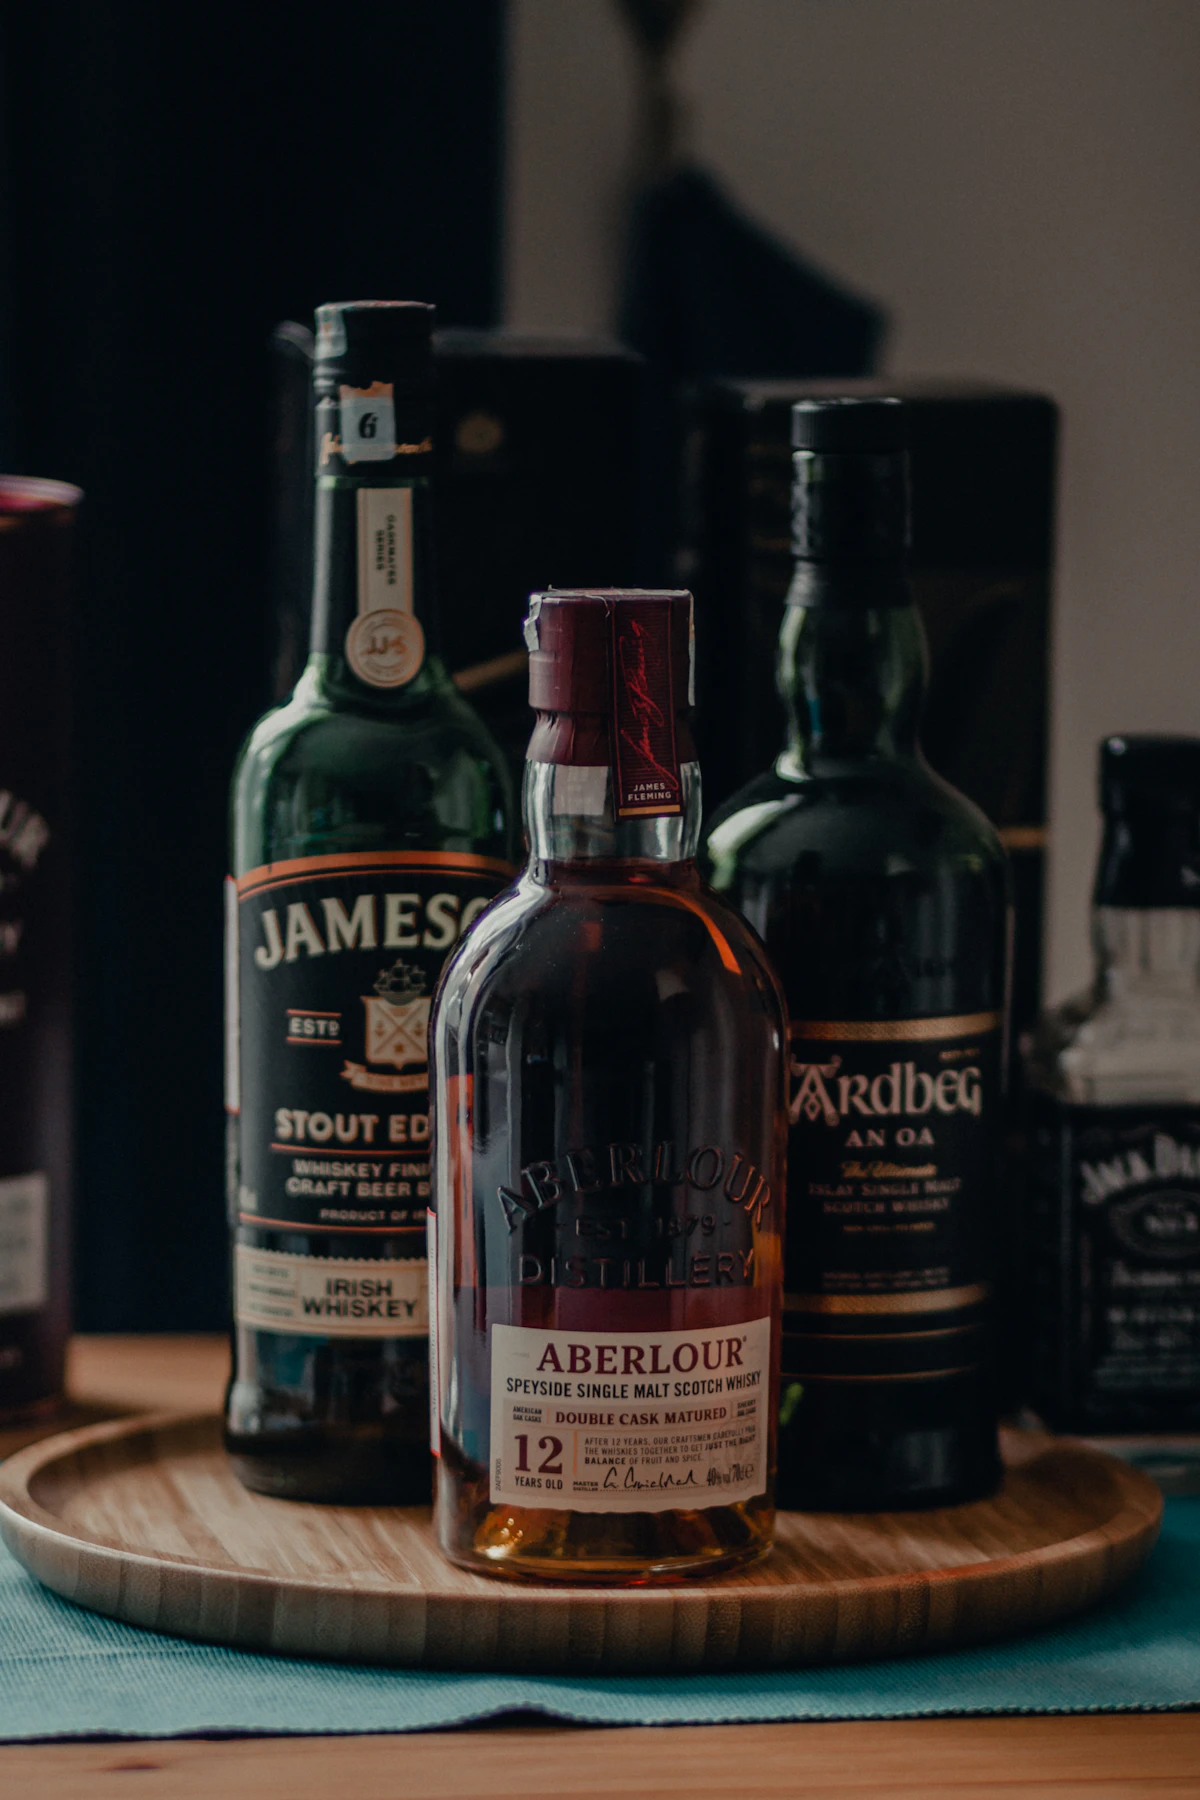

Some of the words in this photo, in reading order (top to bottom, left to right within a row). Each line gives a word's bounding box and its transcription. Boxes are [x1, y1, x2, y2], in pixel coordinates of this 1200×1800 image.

[359, 411, 378, 439] 6
[376, 529, 385, 571] SERIES
[627, 790, 672, 802] FLEMING
[633, 782, 666, 792] JAMES
[275, 1107, 379, 1144] STOUT
[844, 1128, 887, 1148] AN
[894, 1126, 936, 1147] OA
[293, 1158, 383, 1178] WHISKEY
[286, 1176, 351, 1197] CRAFT
[356, 1181, 411, 1198] BEER
[497, 1140, 772, 1233] ABERLOUR
[320, 1207, 385, 1221] PRODUCT
[390, 1209, 408, 1221] OF
[655, 1212, 717, 1238] 1879
[518, 1248, 756, 1289] DISTILLERY
[326, 1278, 393, 1297] IRISH
[303, 1299, 418, 1317] WHISKEY
[536, 1337, 743, 1375] ABERLOUR
[506, 1377, 572, 1398] SPEYSIDE
[577, 1383, 629, 1398] SINGLE
[634, 1383, 669, 1398] MALT
[674, 1378, 723, 1397] SCOTCH
[726, 1370, 761, 1391] WHISKY
[513, 1405, 542, 1415] AMERICAN
[525, 1415, 542, 1423] CASKS
[555, 1411, 615, 1425] DOUBLE
[619, 1413, 659, 1425] CASK
[664, 1407, 727, 1424] MATURED
[584, 1437, 608, 1446] AFTER
[612, 1438, 621, 1446] 12
[624, 1436, 651, 1446] YEARS,
[653, 1436, 668, 1444] OUR
[671, 1434, 711, 1444] CRAFTSMEN
[584, 1447, 599, 1455] THE
[601, 1447, 638, 1455] WHISKIES
[640, 1445, 678, 1455] TOGETHER
[680, 1445, 689, 1453] TO
[705, 1441, 722, 1451] JUST
[725, 1439, 737, 1448] THE
[514, 1434, 563, 1474] 12
[584, 1457, 626, 1465] BALANCE
[629, 1457, 638, 1465] OF
[641, 1456, 662, 1464] FRUIT
[665, 1454, 679, 1463] AND
[515, 1475, 542, 1488] YEARS
[545, 1478, 563, 1490] OLD
